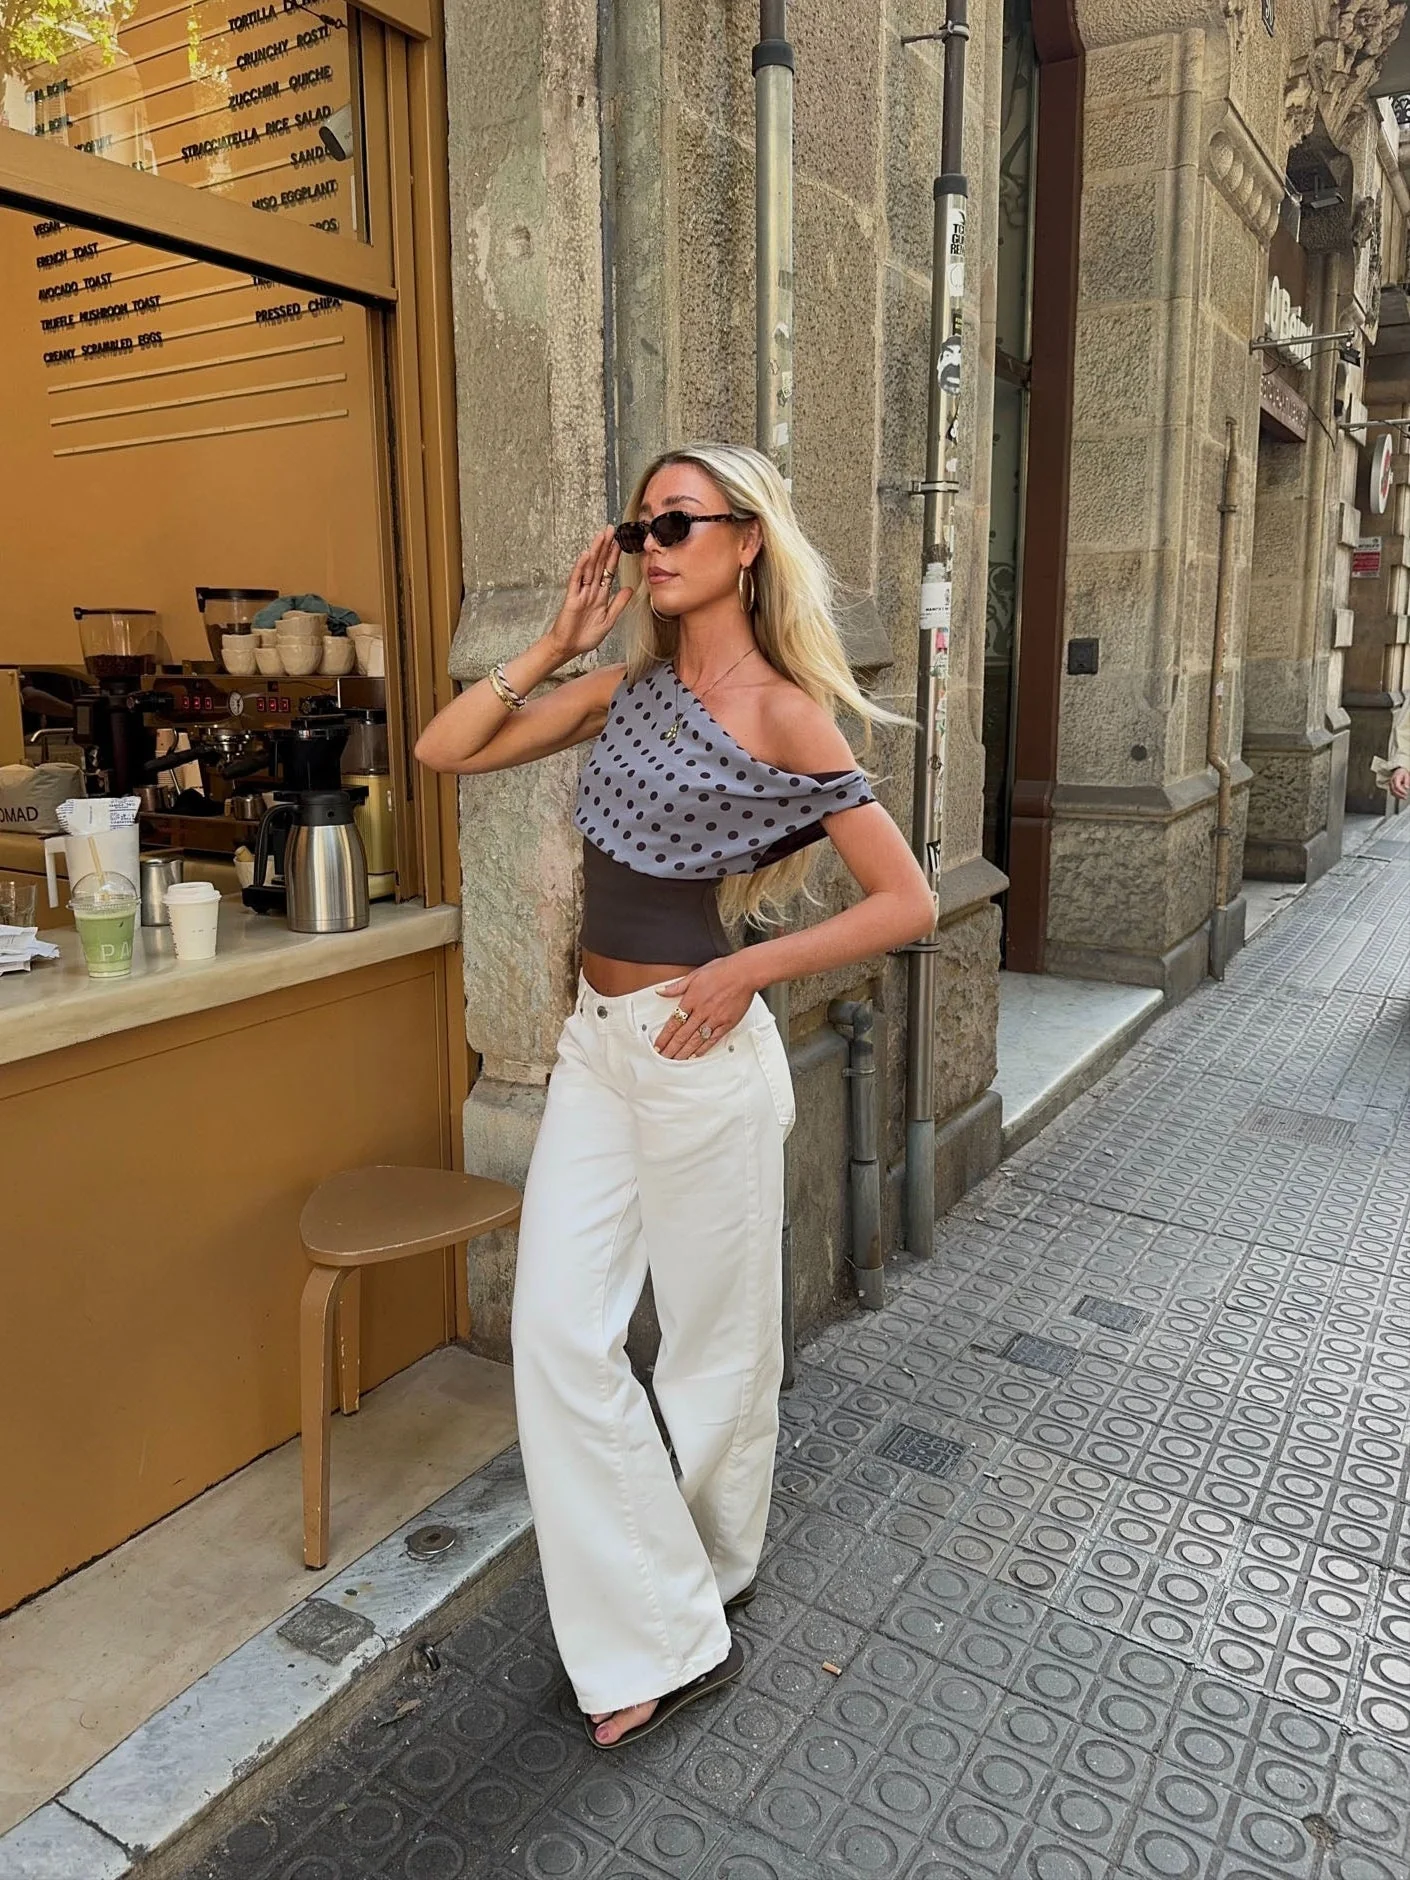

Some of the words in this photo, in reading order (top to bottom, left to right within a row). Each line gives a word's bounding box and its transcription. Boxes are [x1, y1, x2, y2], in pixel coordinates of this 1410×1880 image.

[228, 5, 277, 31] TORTILLA
[237, 39, 288, 68] CRUNCHY
[228, 81, 280, 108] ZUCCHINI
[289, 65, 332, 90] QUICHE
[181, 127, 259, 159] STRACCIATELLA
[265, 117, 290, 134] RICE
[295, 105, 332, 126] SALAD
[281, 179, 338, 205] EGGPLANT
[37, 250, 67, 268] FRENCH
[72, 242, 98, 260] TOAST
[38, 281, 79, 300] AVOCADO
[83, 272, 112, 290] TOAST
[40, 314, 74, 331] TRUFFLE
[79, 303, 129, 322] MUSHROOM
[132, 295, 161, 312] TOAST
[256, 303, 300, 322] PRESSED
[43, 348, 75, 364] CREAMY
[81, 338, 133, 356] SCRAMBLED
[138, 332, 163, 346] EGGS
